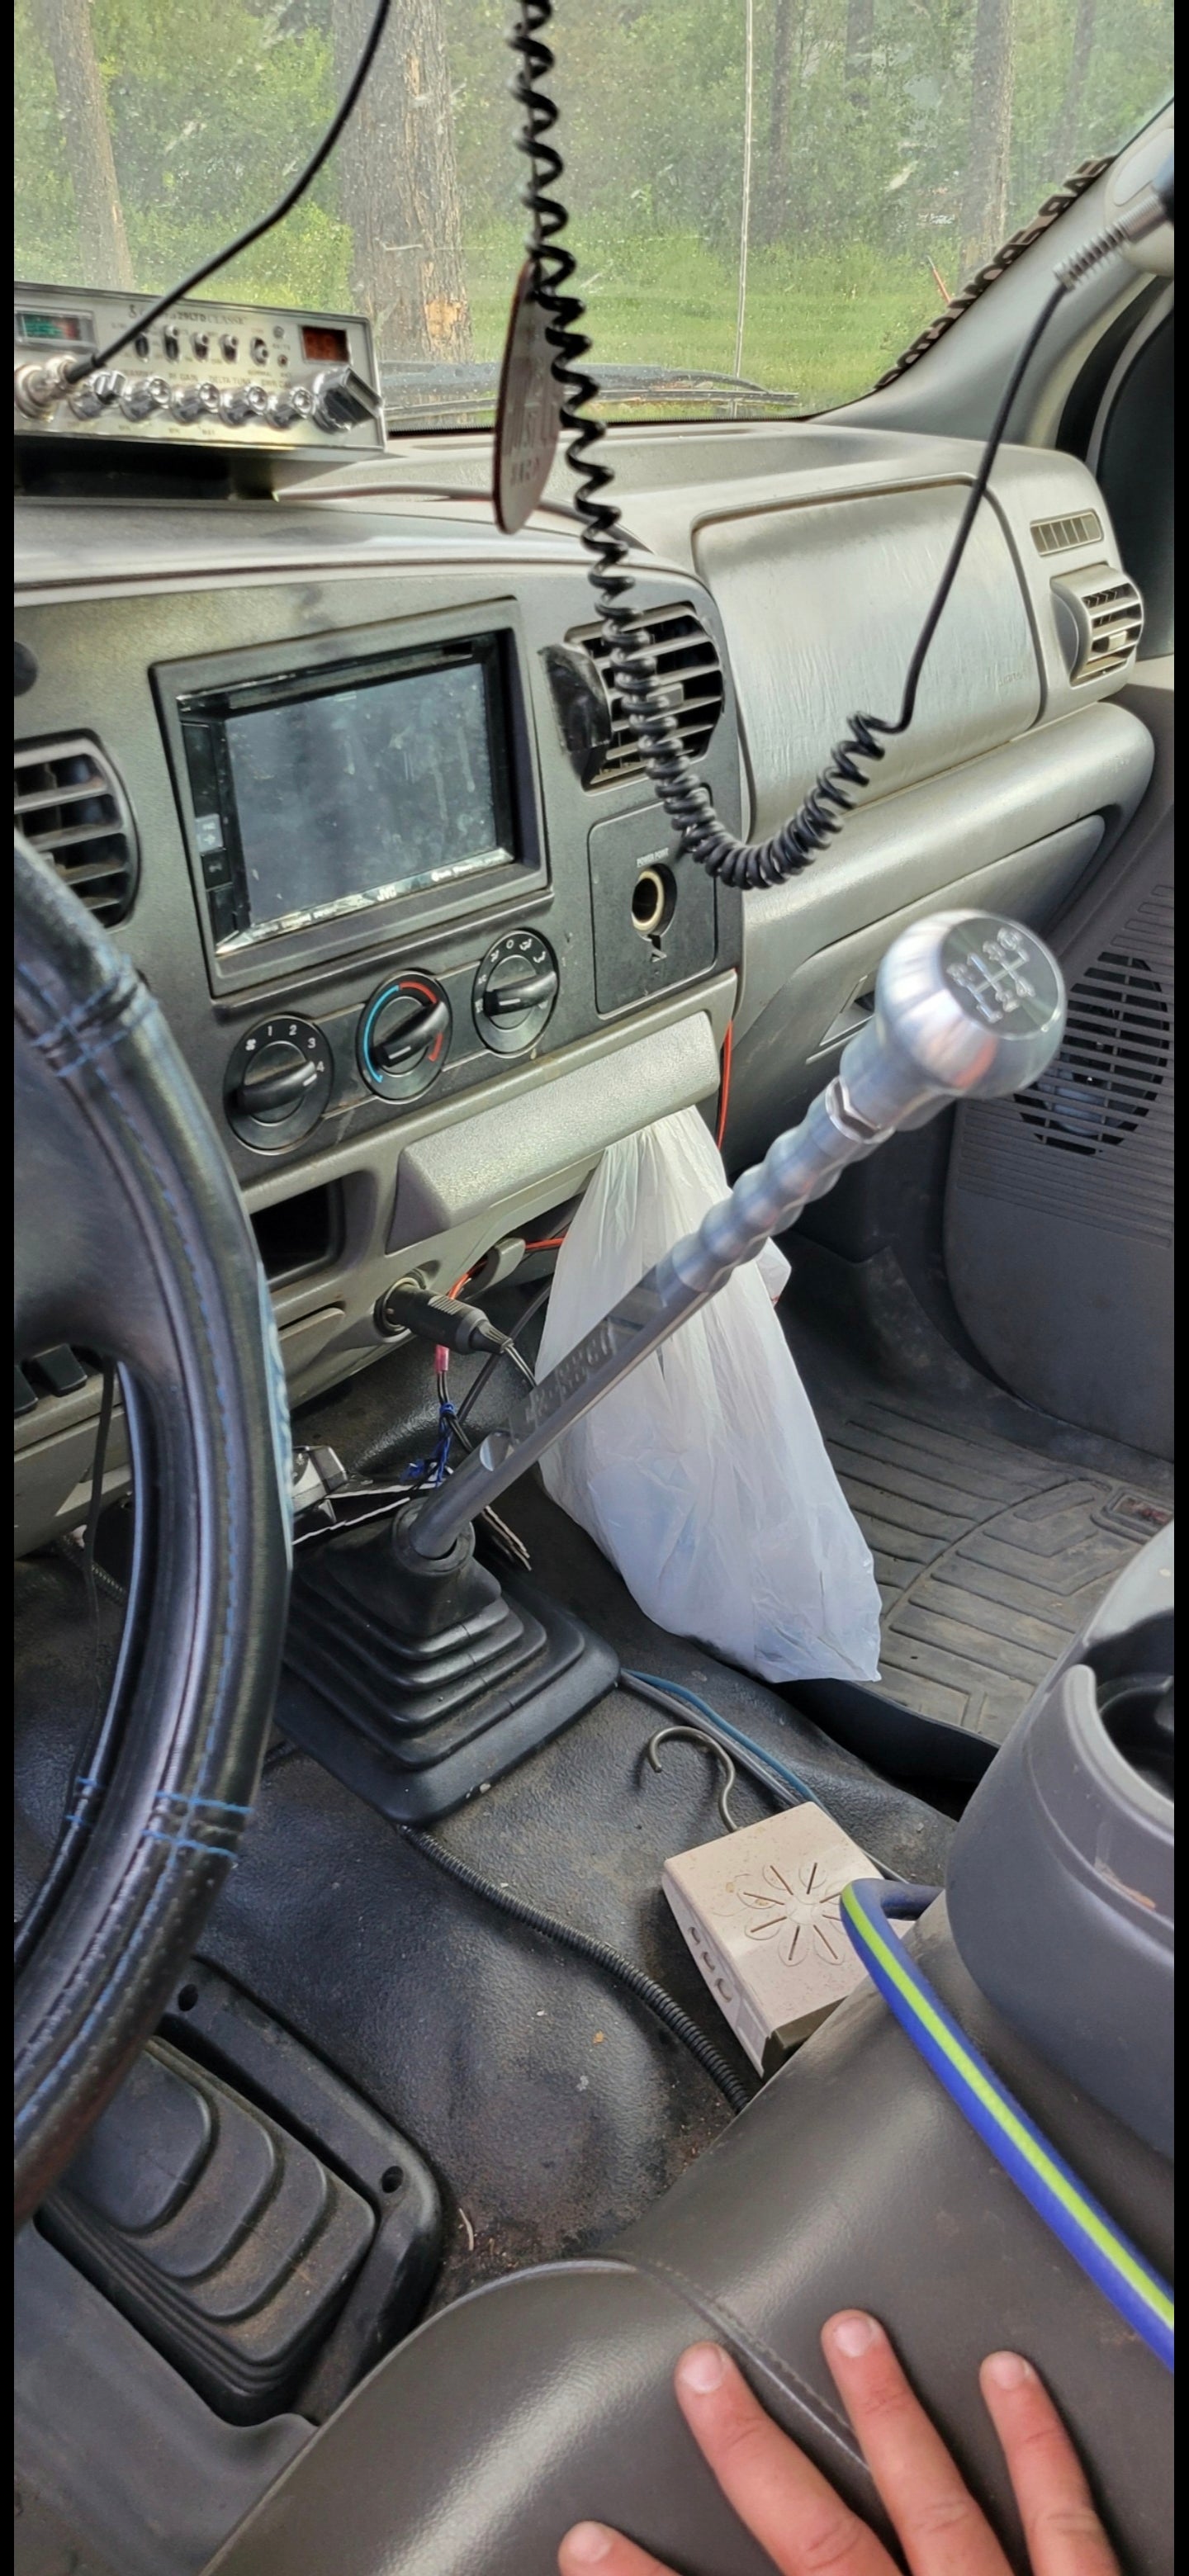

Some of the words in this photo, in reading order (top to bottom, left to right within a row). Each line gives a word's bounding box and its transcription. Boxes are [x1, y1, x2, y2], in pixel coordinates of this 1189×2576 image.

[377, 884, 397, 902] JVC
[268, 1025, 273, 1037] 1
[288, 1024, 297, 1036] 2
[307, 1036, 316, 1049] 3
[316, 1060, 325, 1073] 4
